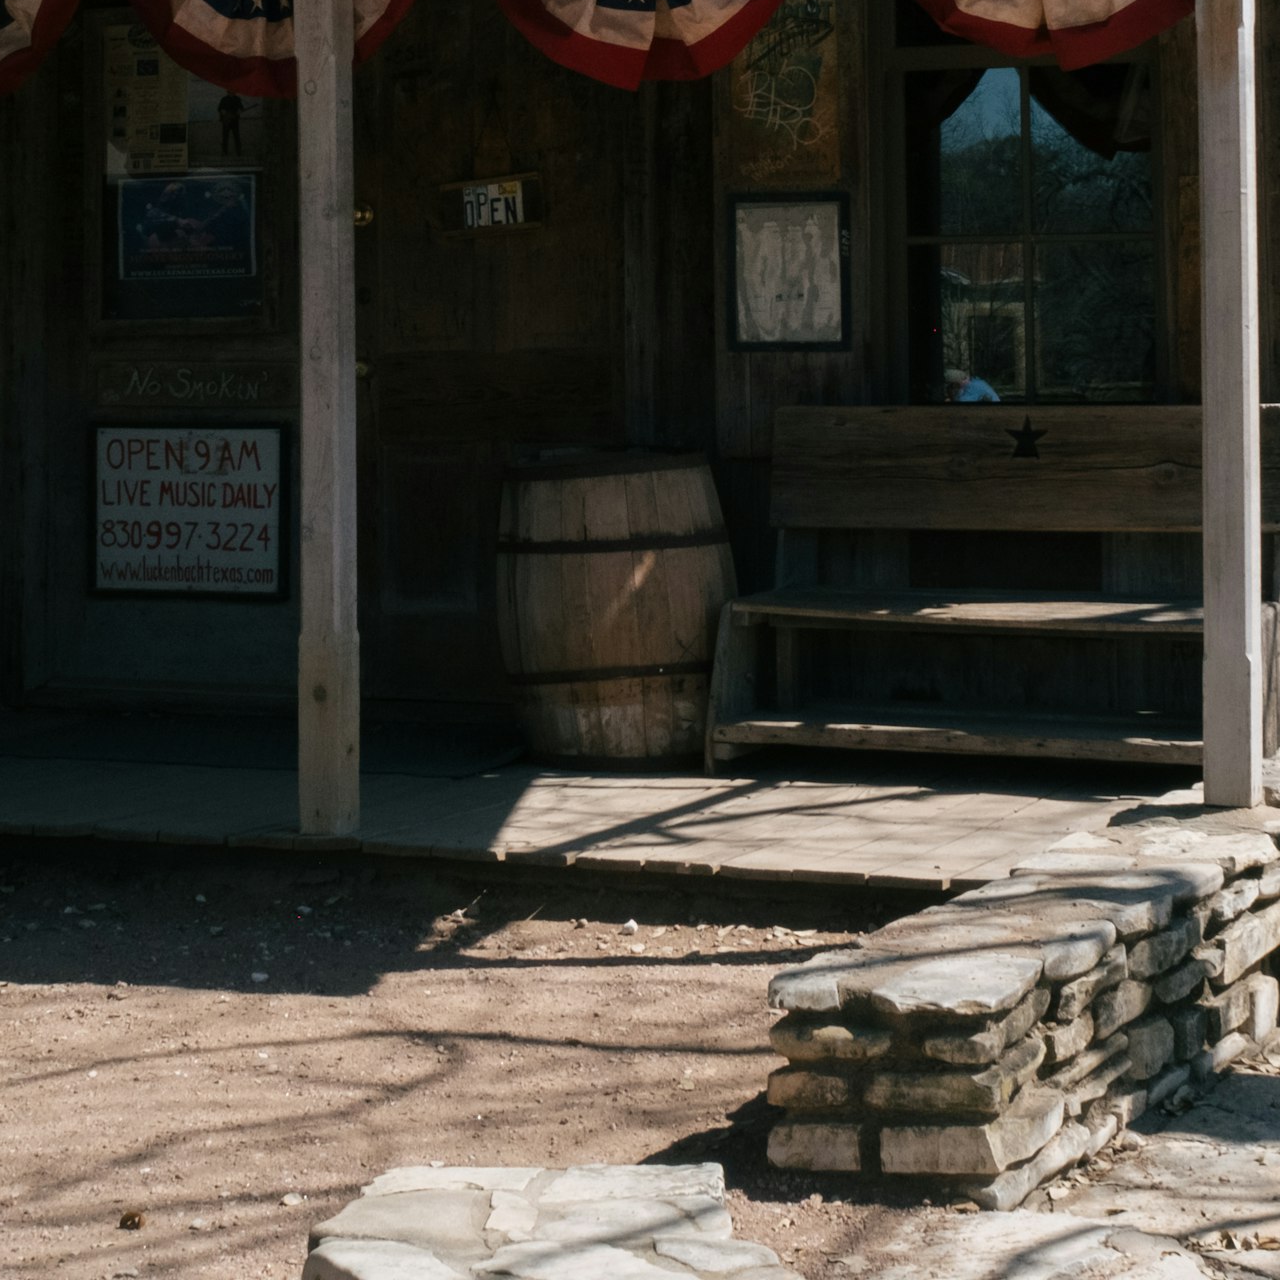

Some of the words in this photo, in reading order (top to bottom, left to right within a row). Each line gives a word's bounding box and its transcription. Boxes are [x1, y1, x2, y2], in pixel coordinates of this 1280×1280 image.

[464, 192, 518, 229] OPEN
[124, 367, 161, 396] No
[106, 438, 184, 470] OPEN
[194, 439, 211, 471] 9
[218, 439, 262, 472] AM
[102, 480, 151, 507] LIVE
[158, 481, 217, 507] MUSIC
[221, 482, 277, 509] DAILY
